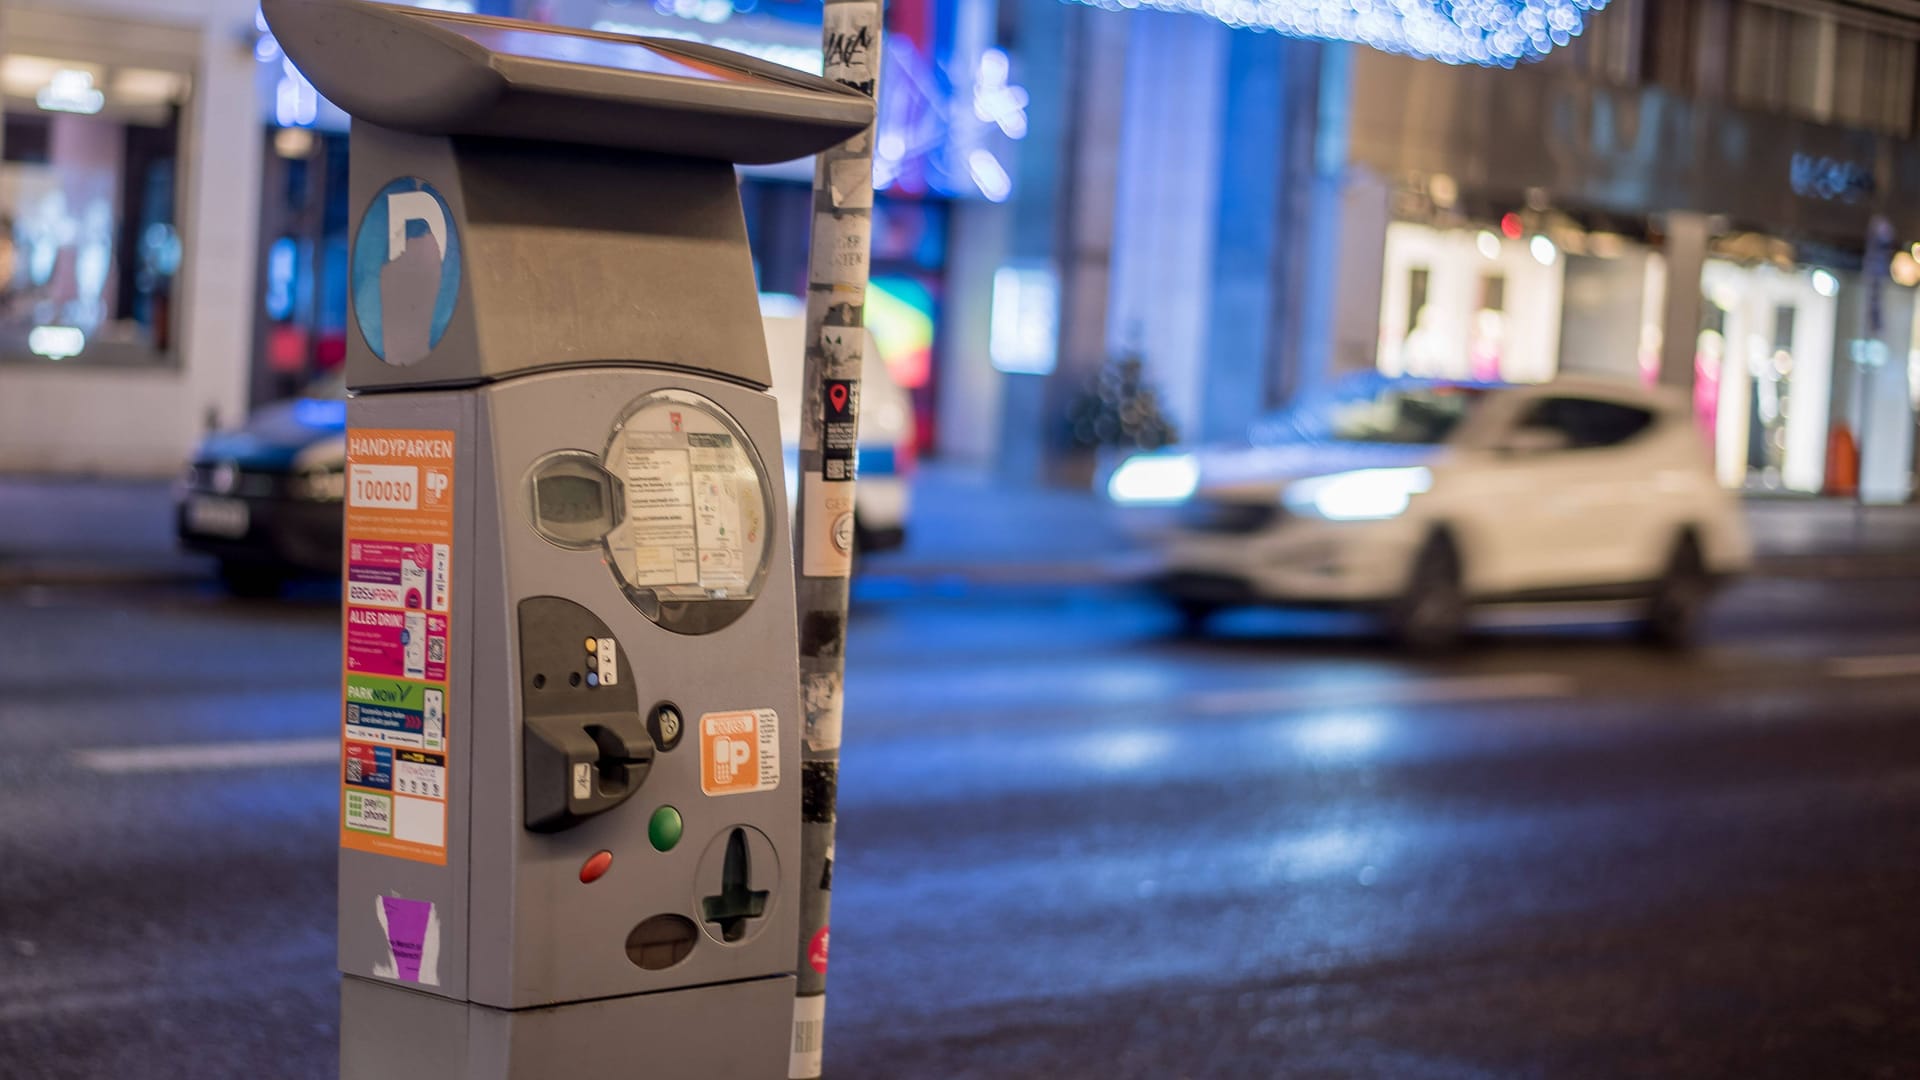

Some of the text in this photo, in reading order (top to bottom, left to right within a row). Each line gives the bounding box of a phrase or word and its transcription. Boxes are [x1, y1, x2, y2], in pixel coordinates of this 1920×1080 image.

[350, 438, 453, 458] HANDYPARKEN
[357, 480, 412, 502] 100030
[350, 610, 378, 625] ALLES
[364, 810, 388, 822] phone
